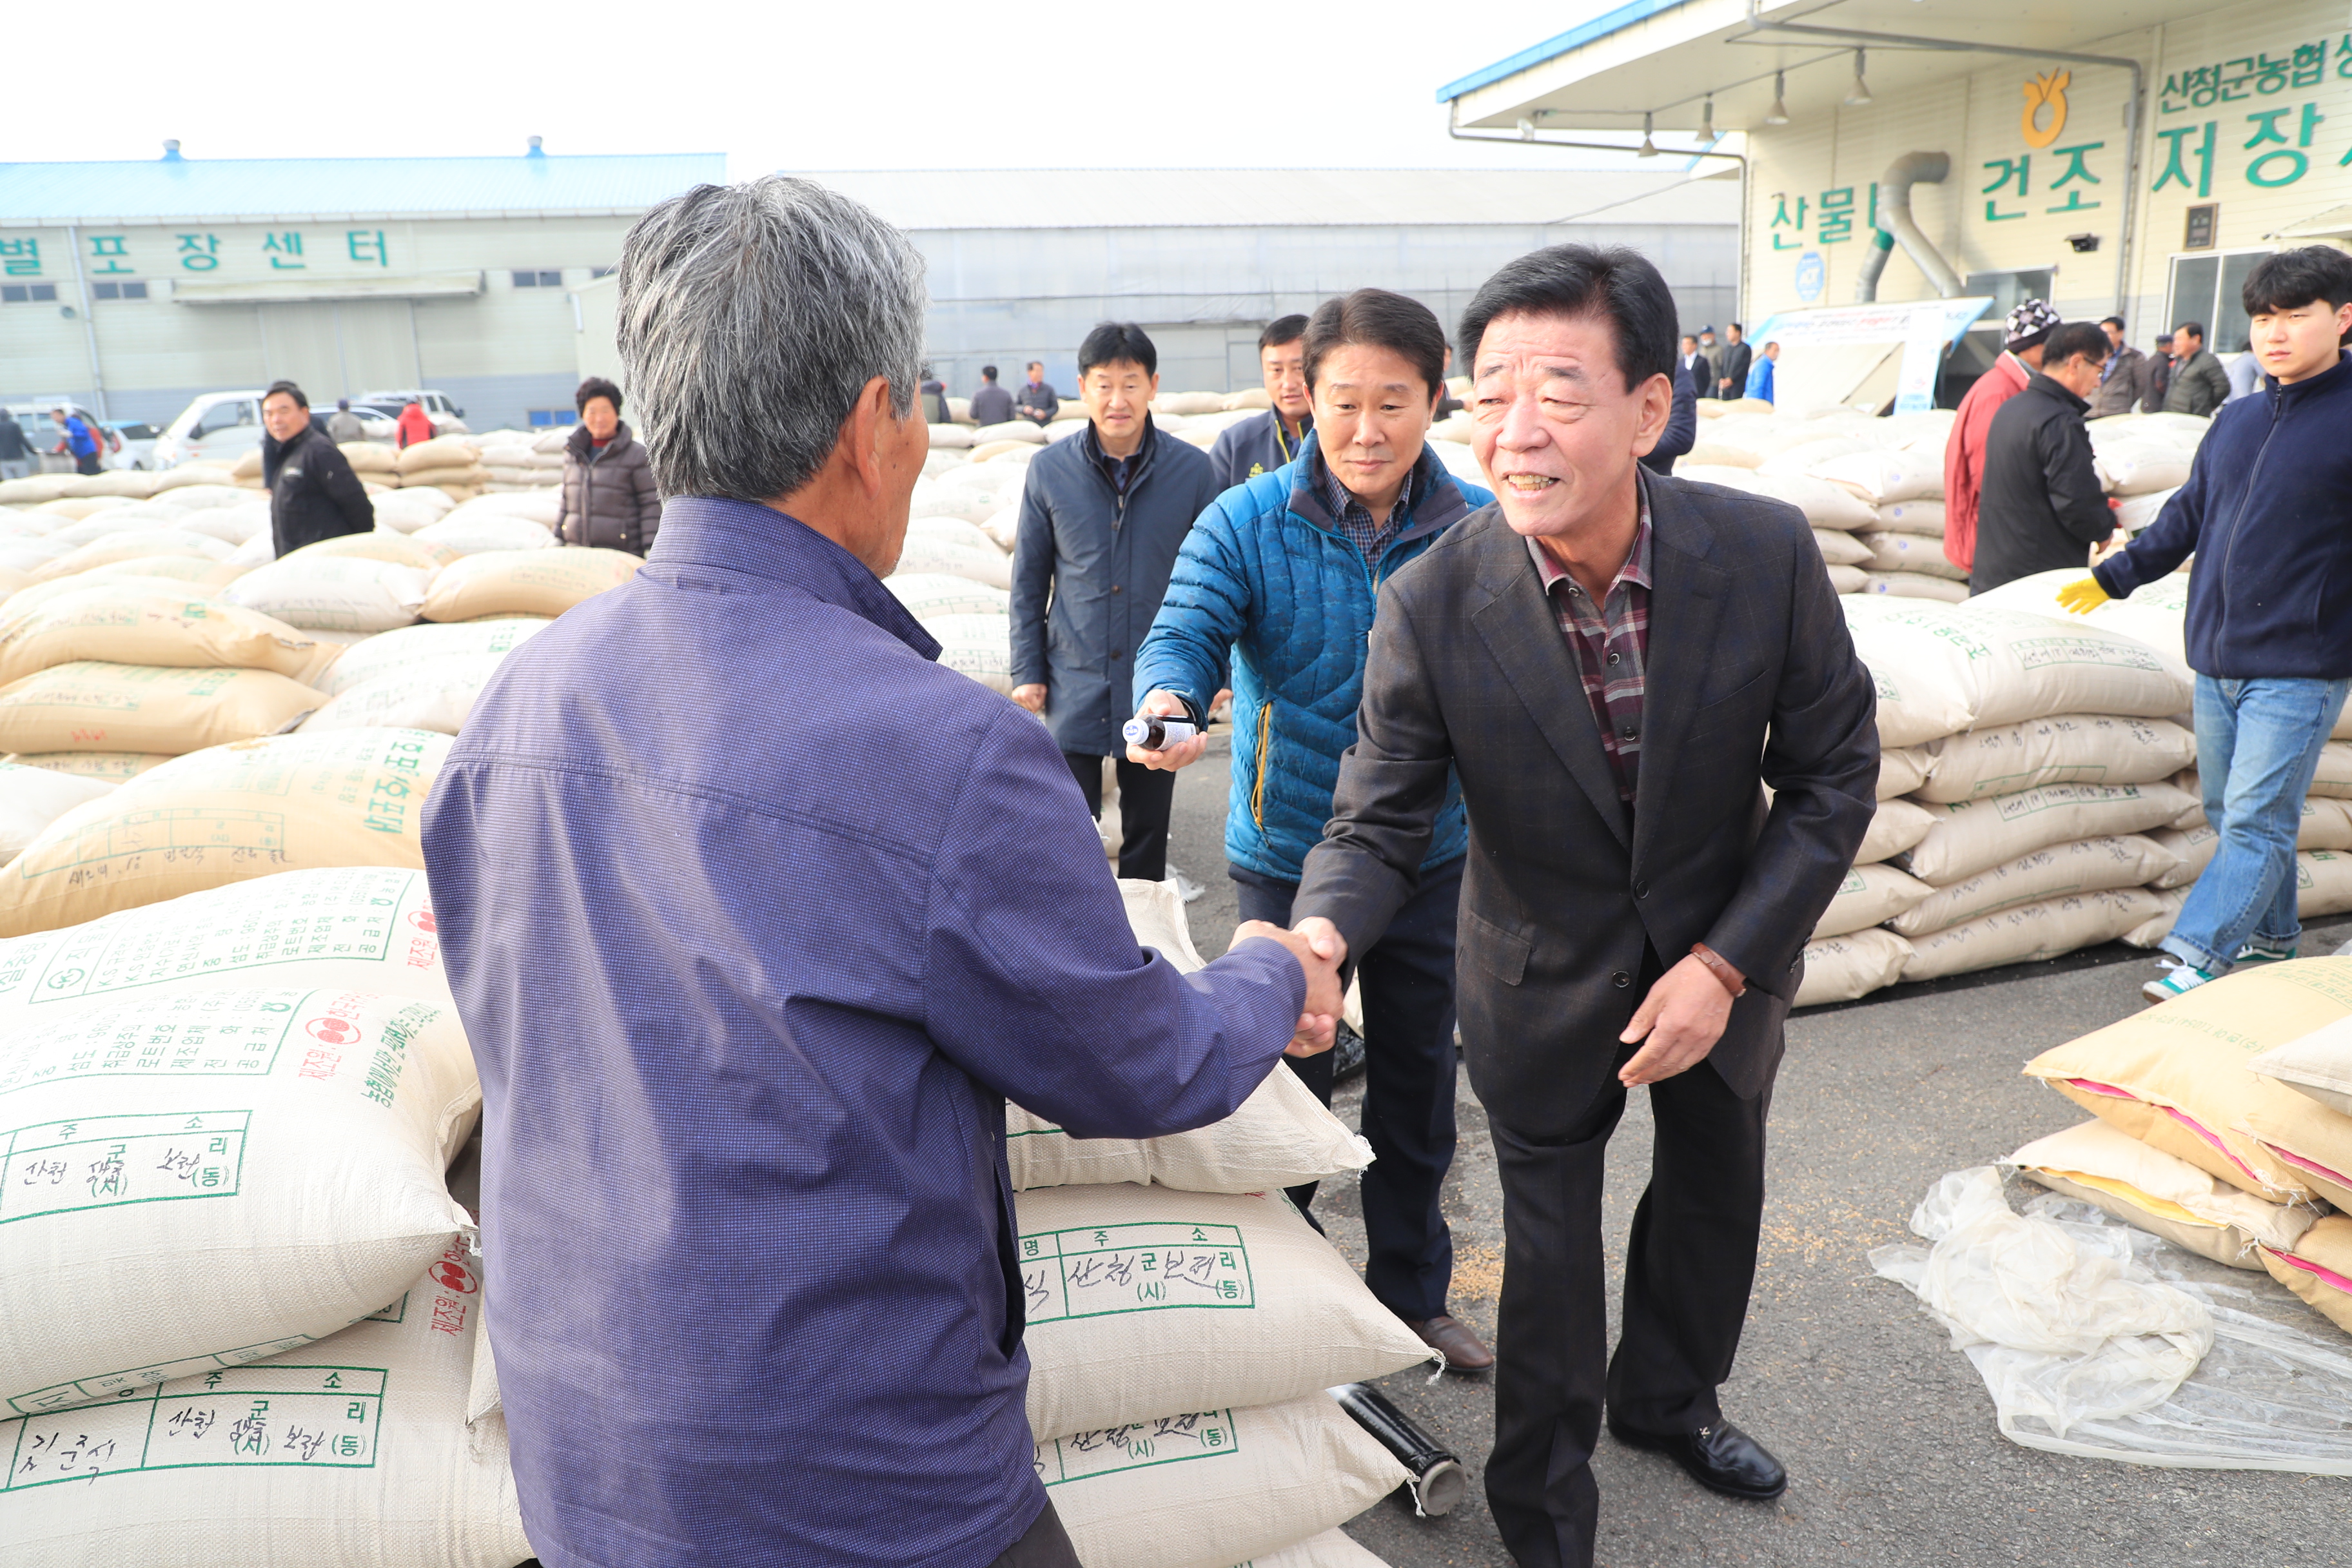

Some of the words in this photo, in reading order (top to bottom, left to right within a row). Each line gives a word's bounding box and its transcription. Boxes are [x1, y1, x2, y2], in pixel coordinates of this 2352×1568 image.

[2159, 43, 2326, 113] 산청군농협
[1771, 181, 1881, 250] 산물
[1981, 141, 2106, 222] 건조
[281, 916, 310, 956] 로트번호
[306, 916, 335, 955] 제조업체
[230, 945, 250, 965] 섬도
[97, 968, 117, 987] K.S
[124, 961, 146, 983] K.S
[101, 1024, 144, 1068] 취급상주의
[137, 1023, 179, 1068] 로트번호
[172, 1024, 212, 1070] 제조업체
[67, 1048, 97, 1072] 섬도
[59, 1123, 79, 1140] 주
[183, 1115, 204, 1130] 소
[107, 1144, 128, 1163] 군
[208, 1136, 229, 1155] 리
[191, 1165, 230, 1188] (동)
[1023, 1240, 1039, 1256] 명
[1093, 1230, 1110, 1246] 주
[1191, 1227, 1209, 1242] 소
[1141, 1252, 1157, 1271] 군
[1219, 1251, 1237, 1271] 리
[1137, 1280, 1167, 1302] (시)
[1215, 1279, 1245, 1300] (동)
[204, 1371, 224, 1389] 주
[322, 1371, 342, 1389] 소
[250, 1400, 270, 1420] 군
[347, 1401, 367, 1424] 리
[331, 1434, 368, 1456] (동)
[1128, 1438, 1155, 1460] (시)
[1200, 1427, 1228, 1448] (동)
